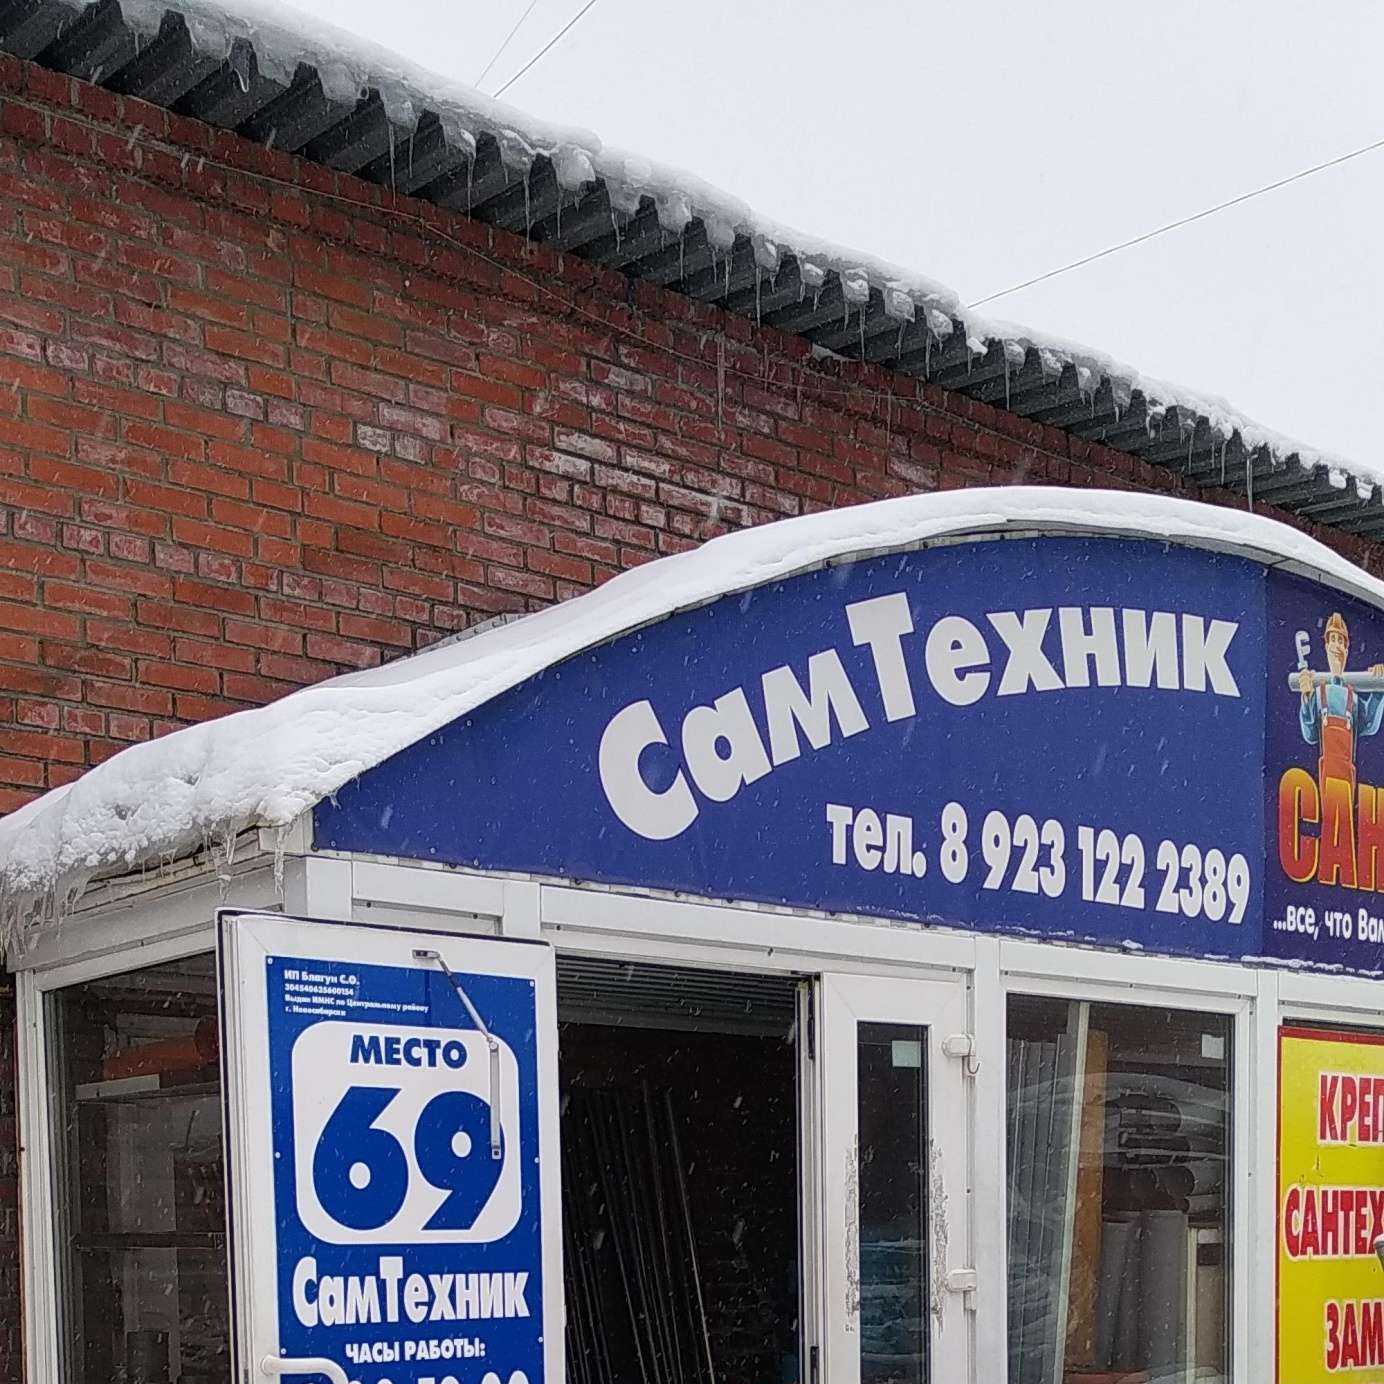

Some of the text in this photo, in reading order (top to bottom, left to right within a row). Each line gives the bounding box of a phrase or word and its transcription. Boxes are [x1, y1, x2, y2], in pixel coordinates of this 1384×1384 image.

[599, 592, 1240, 841] СамТехник
[826, 801, 1250, 925] тел. 8 923 122 2389
[1324, 910, 1352, 939] что
[284, 970, 300, 981] ИП
[350, 1034, 467, 1069] МЕСТО
[312, 1086, 506, 1231] 69
[292, 1256, 531, 1328] СамТехник
[345, 1338, 486, 1364] ЧАСЫ РАБОТЫ:
[1326, 1302, 1384, 1371] ЗАМ
